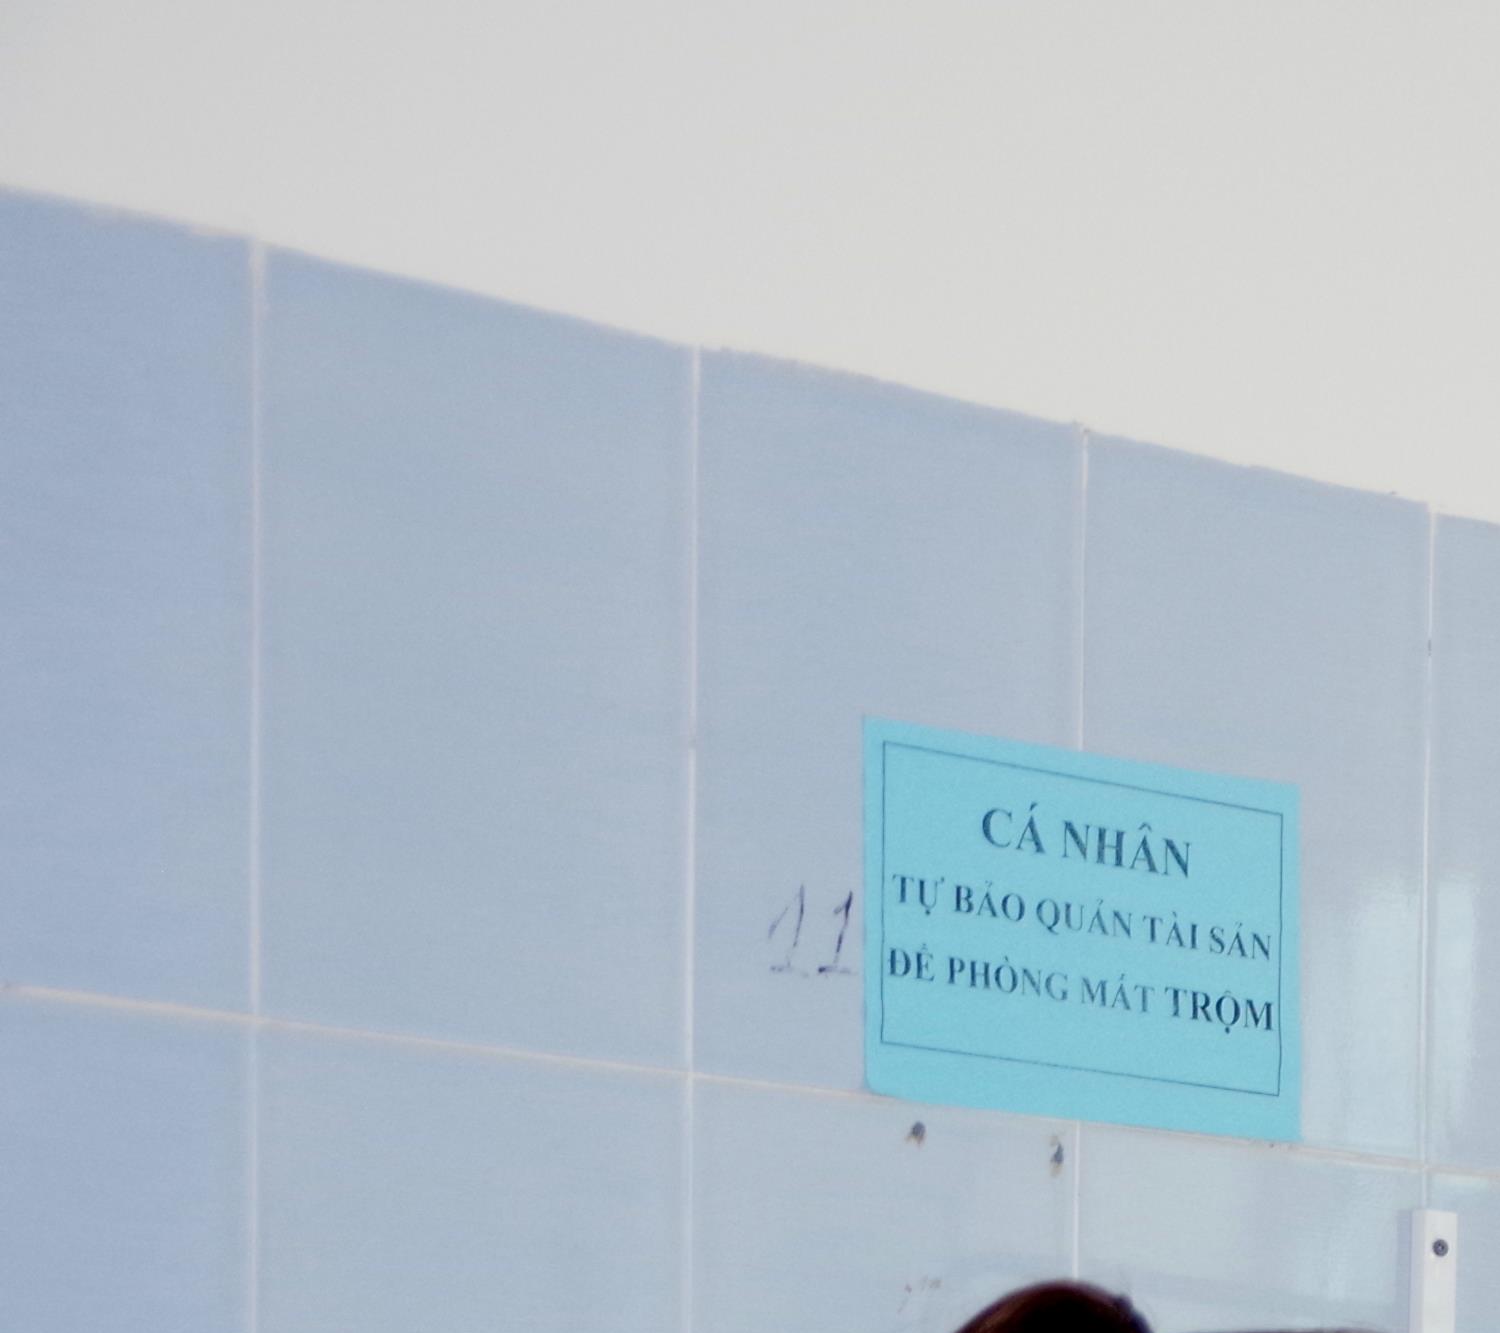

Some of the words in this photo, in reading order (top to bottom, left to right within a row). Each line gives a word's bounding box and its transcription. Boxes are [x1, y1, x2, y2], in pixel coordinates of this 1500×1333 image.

[982, 802, 1046, 853] CÁ
[1062, 820, 1192, 878] NHÂN
[892, 873, 945, 916] TỰ
[954, 880, 1026, 922] BẢO
[1036, 899, 1132, 939] QUẢN
[1143, 911, 1200, 950] TÀI
[1209, 921, 1271, 961] SẢN
[948, 955, 1069, 1002] PHÒNG
[1165, 990, 1274, 1035] TRỘM
